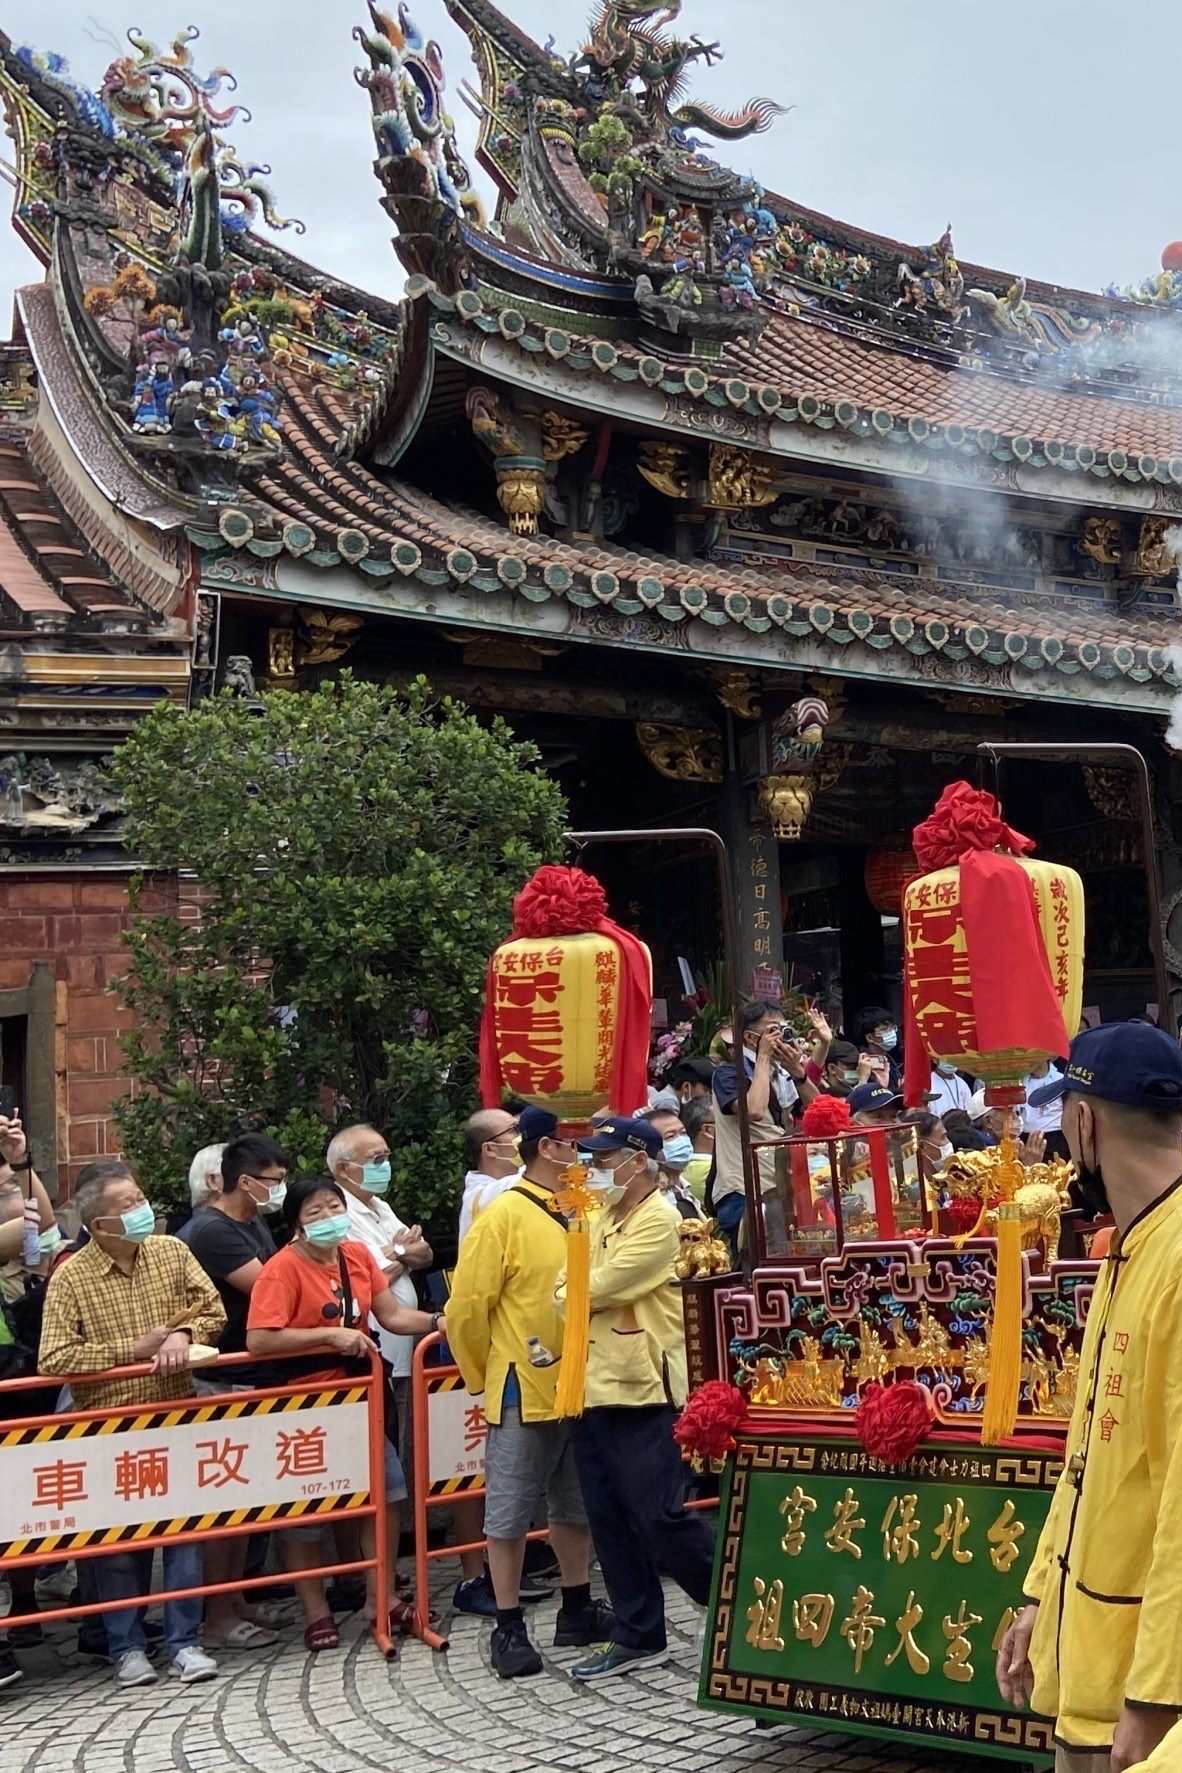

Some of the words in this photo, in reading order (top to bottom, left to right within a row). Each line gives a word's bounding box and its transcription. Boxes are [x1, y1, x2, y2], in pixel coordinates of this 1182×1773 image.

[1097, 1331, 1129, 1443] 四祖會
[32, 1426, 329, 1511] 車輛改道
[300, 1478, 351, 1496] 107-172
[19, 1516, 76, 1536] 北市警局
[779, 1486, 1025, 1573] 台北保安宮
[745, 1577, 1025, 1682] 生大帝四祖
